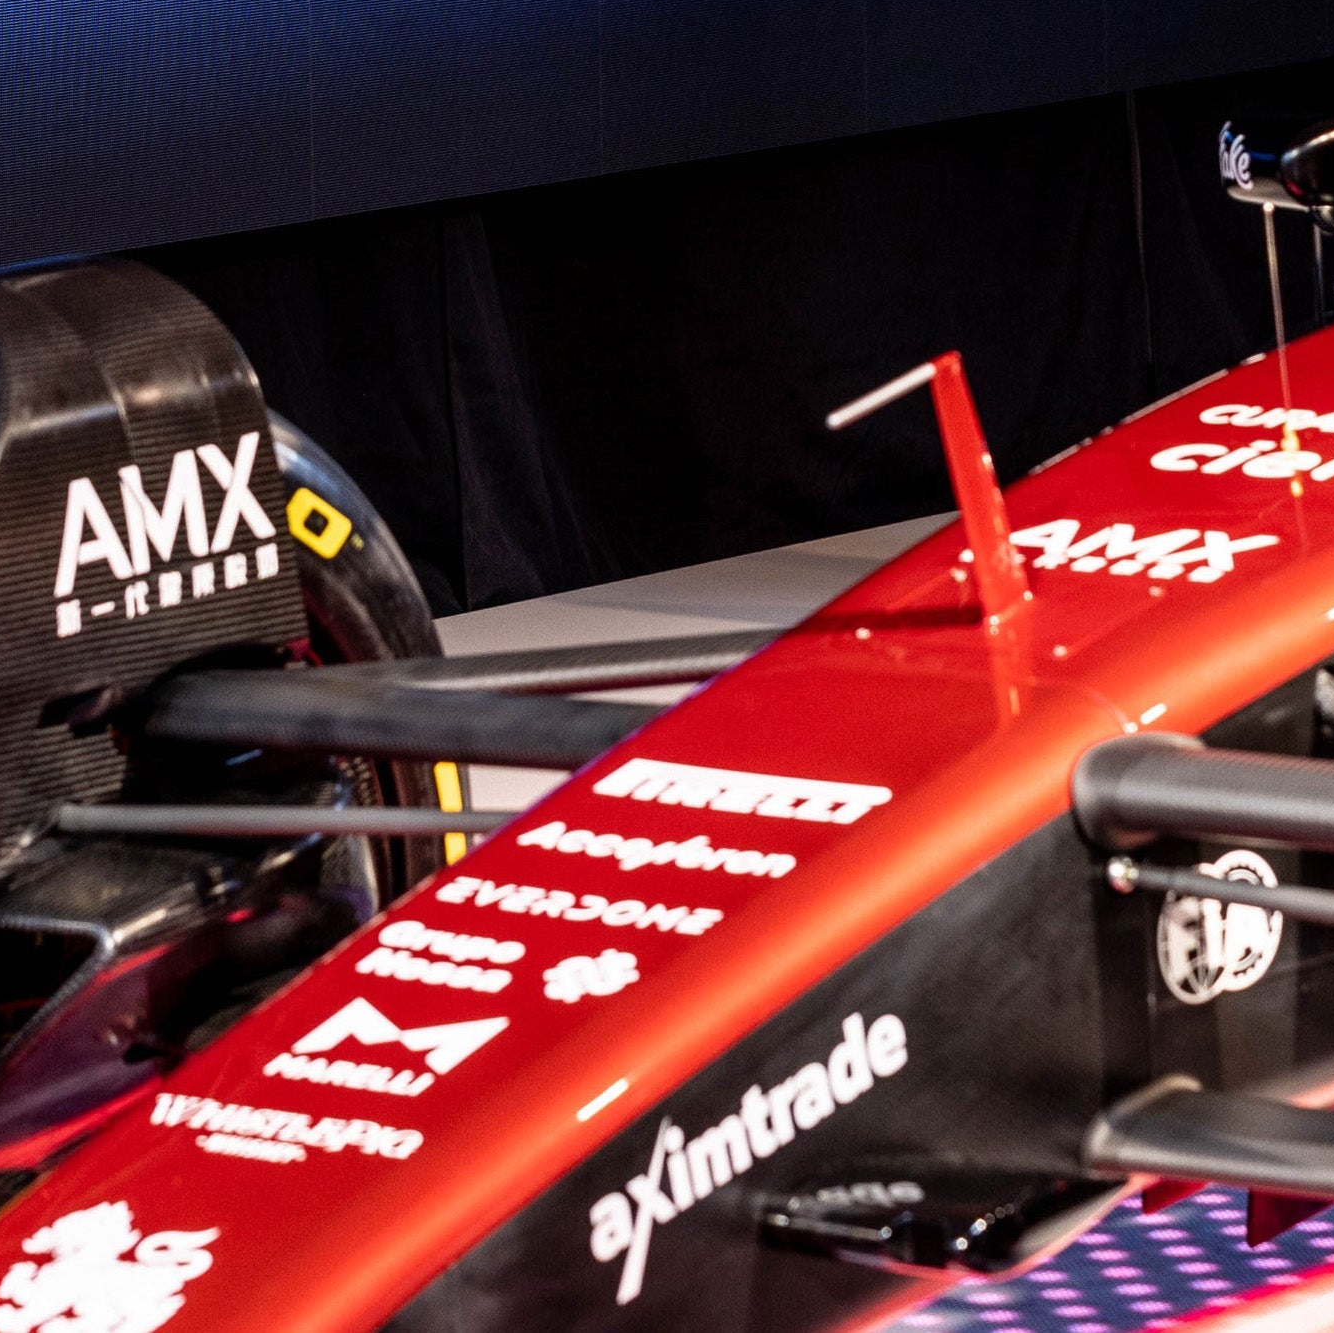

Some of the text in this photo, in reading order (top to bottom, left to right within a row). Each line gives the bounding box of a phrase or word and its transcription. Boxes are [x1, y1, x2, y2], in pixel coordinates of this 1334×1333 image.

[53, 431, 277, 598] AMX
[1008, 518, 1280, 572] AMX
[592, 757, 893, 825] PIRELLI
